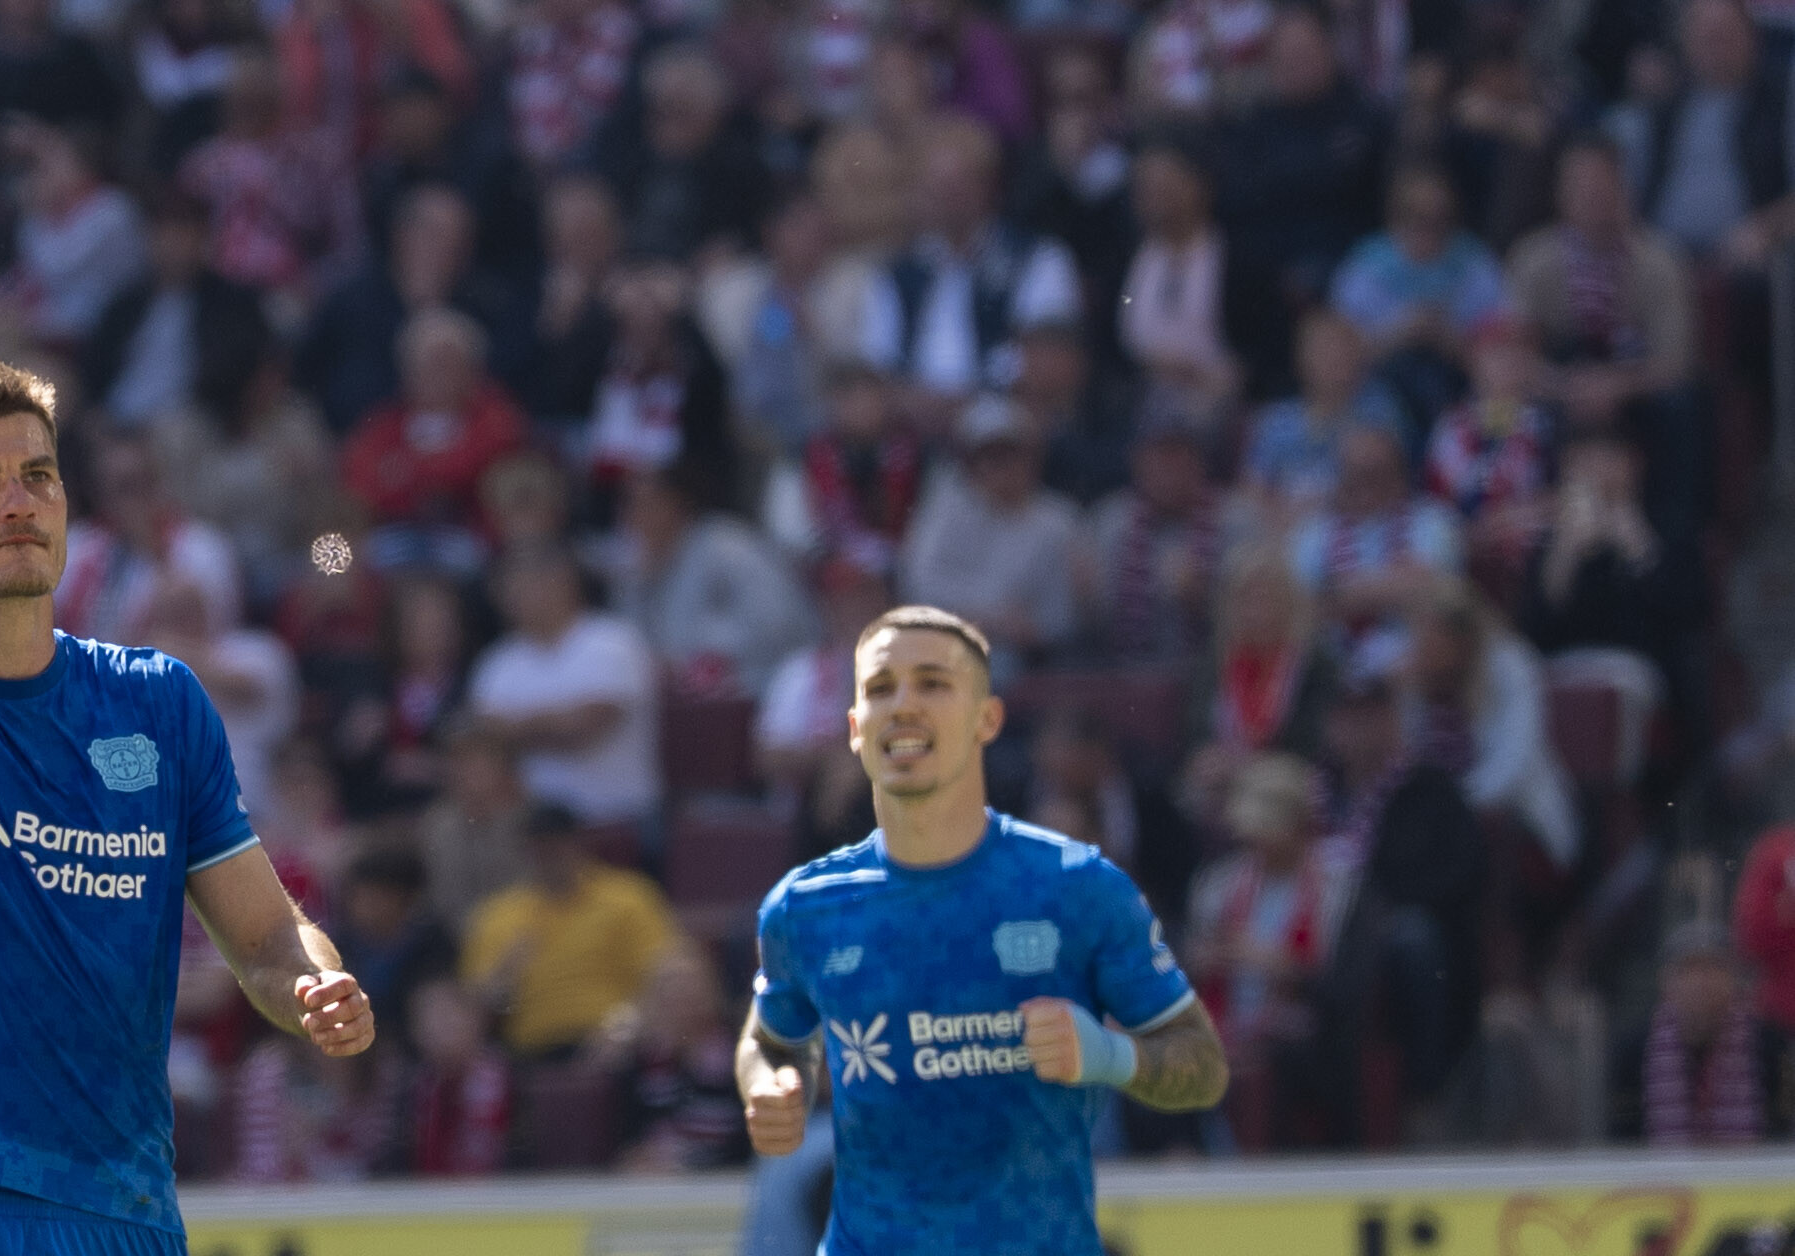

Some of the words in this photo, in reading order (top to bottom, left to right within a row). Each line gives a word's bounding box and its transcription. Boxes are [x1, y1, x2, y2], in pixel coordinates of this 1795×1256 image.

[13, 811, 166, 857] Barmenia
[908, 1010, 1025, 1045] Barme
[913, 1043, 1031, 1081] Gothae
